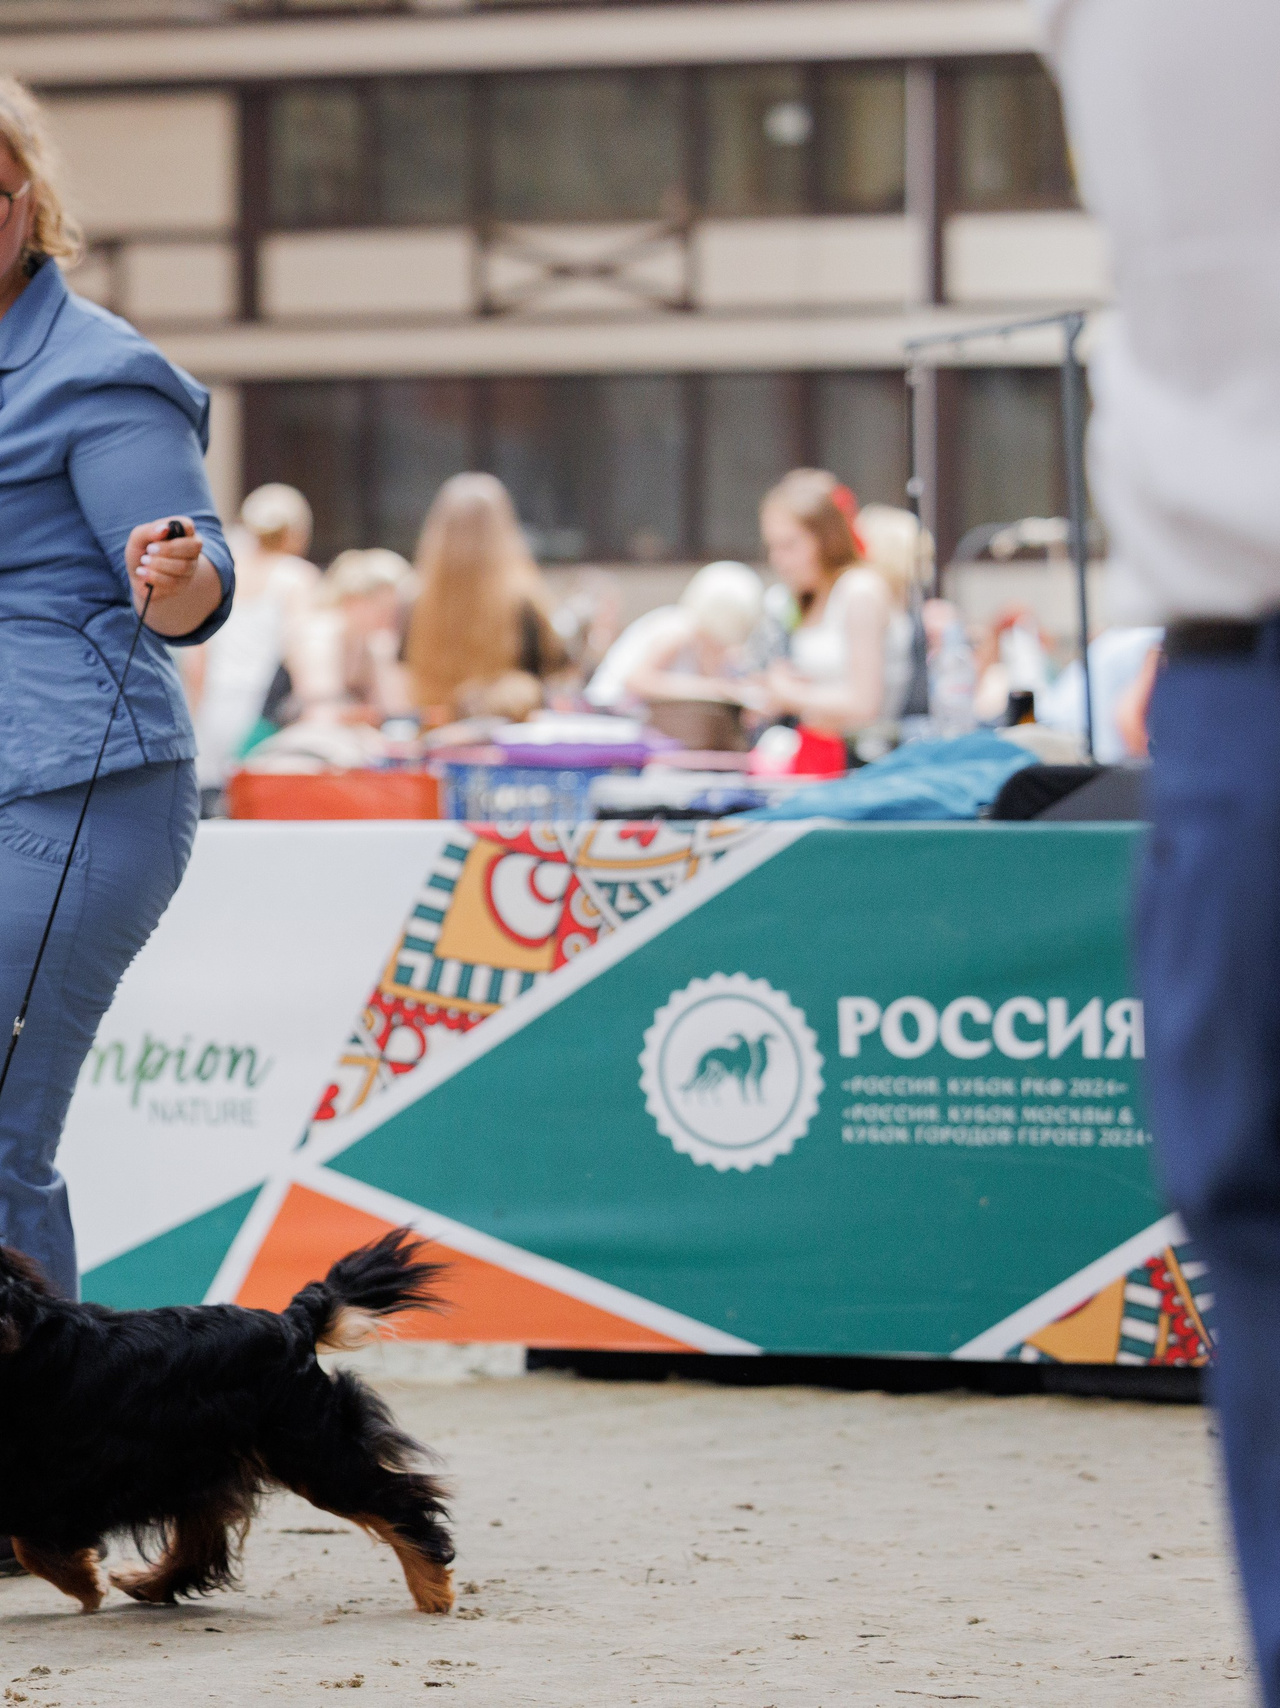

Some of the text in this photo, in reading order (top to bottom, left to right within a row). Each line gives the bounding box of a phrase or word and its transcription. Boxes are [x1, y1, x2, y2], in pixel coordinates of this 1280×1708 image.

[837, 995, 1146, 1060] РОССИЯ
[947, 1075, 1017, 1097] КУБОК
[1021, 1076, 1066, 1097] РКФ
[147, 1098, 257, 1127] NATURE
[947, 1104, 1017, 1125] КУБОК
[1022, 1105, 1114, 1125] МОСКВЫ
[842, 1124, 911, 1144] КУБОК
[915, 1125, 1013, 1146] ГОРОДОВ
[1017, 1125, 1095, 1146] ГЕРОЕВ
